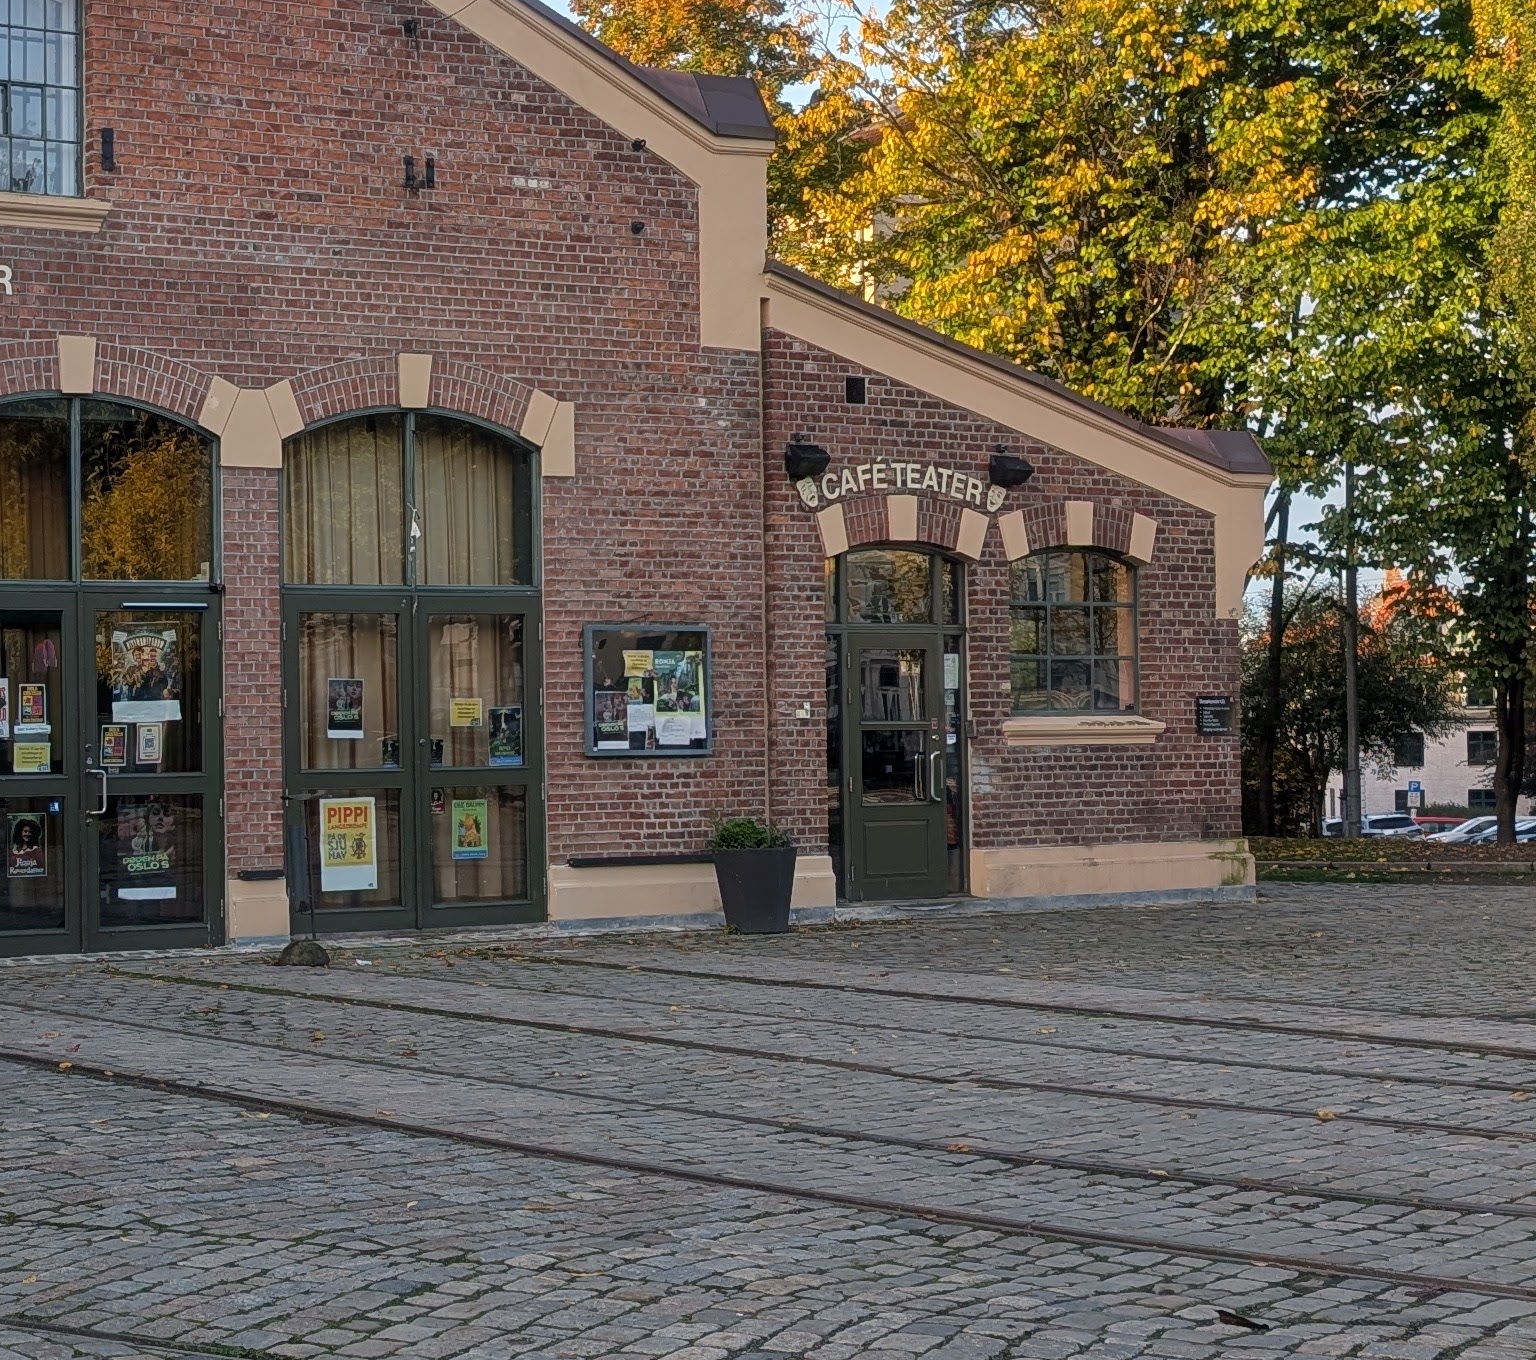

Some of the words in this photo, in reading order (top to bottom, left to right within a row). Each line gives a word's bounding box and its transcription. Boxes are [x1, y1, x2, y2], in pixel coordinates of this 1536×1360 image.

[1410, 782, 1419, 791] P
[328, 806, 367, 823] PIPPI
[328, 840, 346, 850] SJU
[127, 861, 160, 871] OSLO
[161, 860, 170, 869] S
